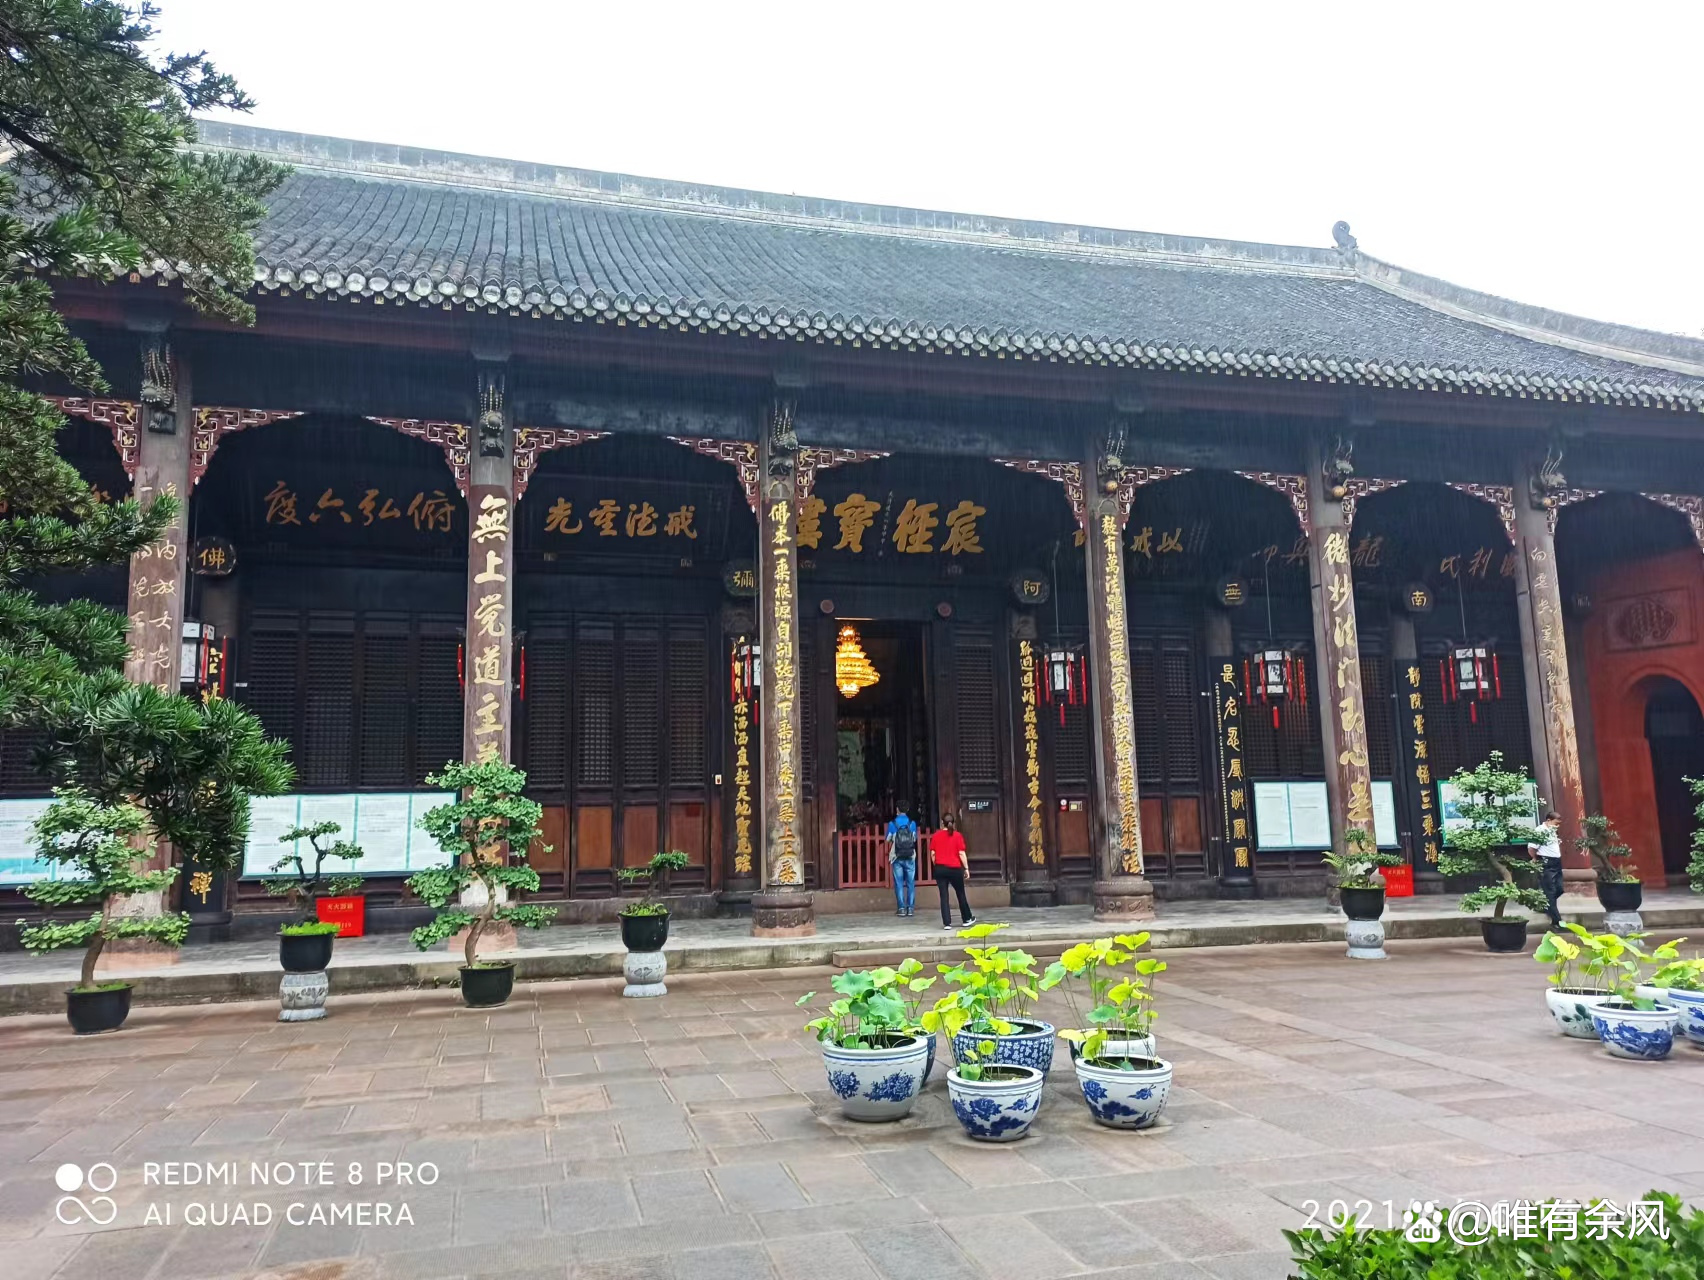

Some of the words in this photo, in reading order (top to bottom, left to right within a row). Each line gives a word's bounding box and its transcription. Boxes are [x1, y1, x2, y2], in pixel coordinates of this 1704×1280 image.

[199, 547, 226, 570] 佛
[1023, 580, 1041, 597] 阿
[1411, 590, 1427, 607] 南
